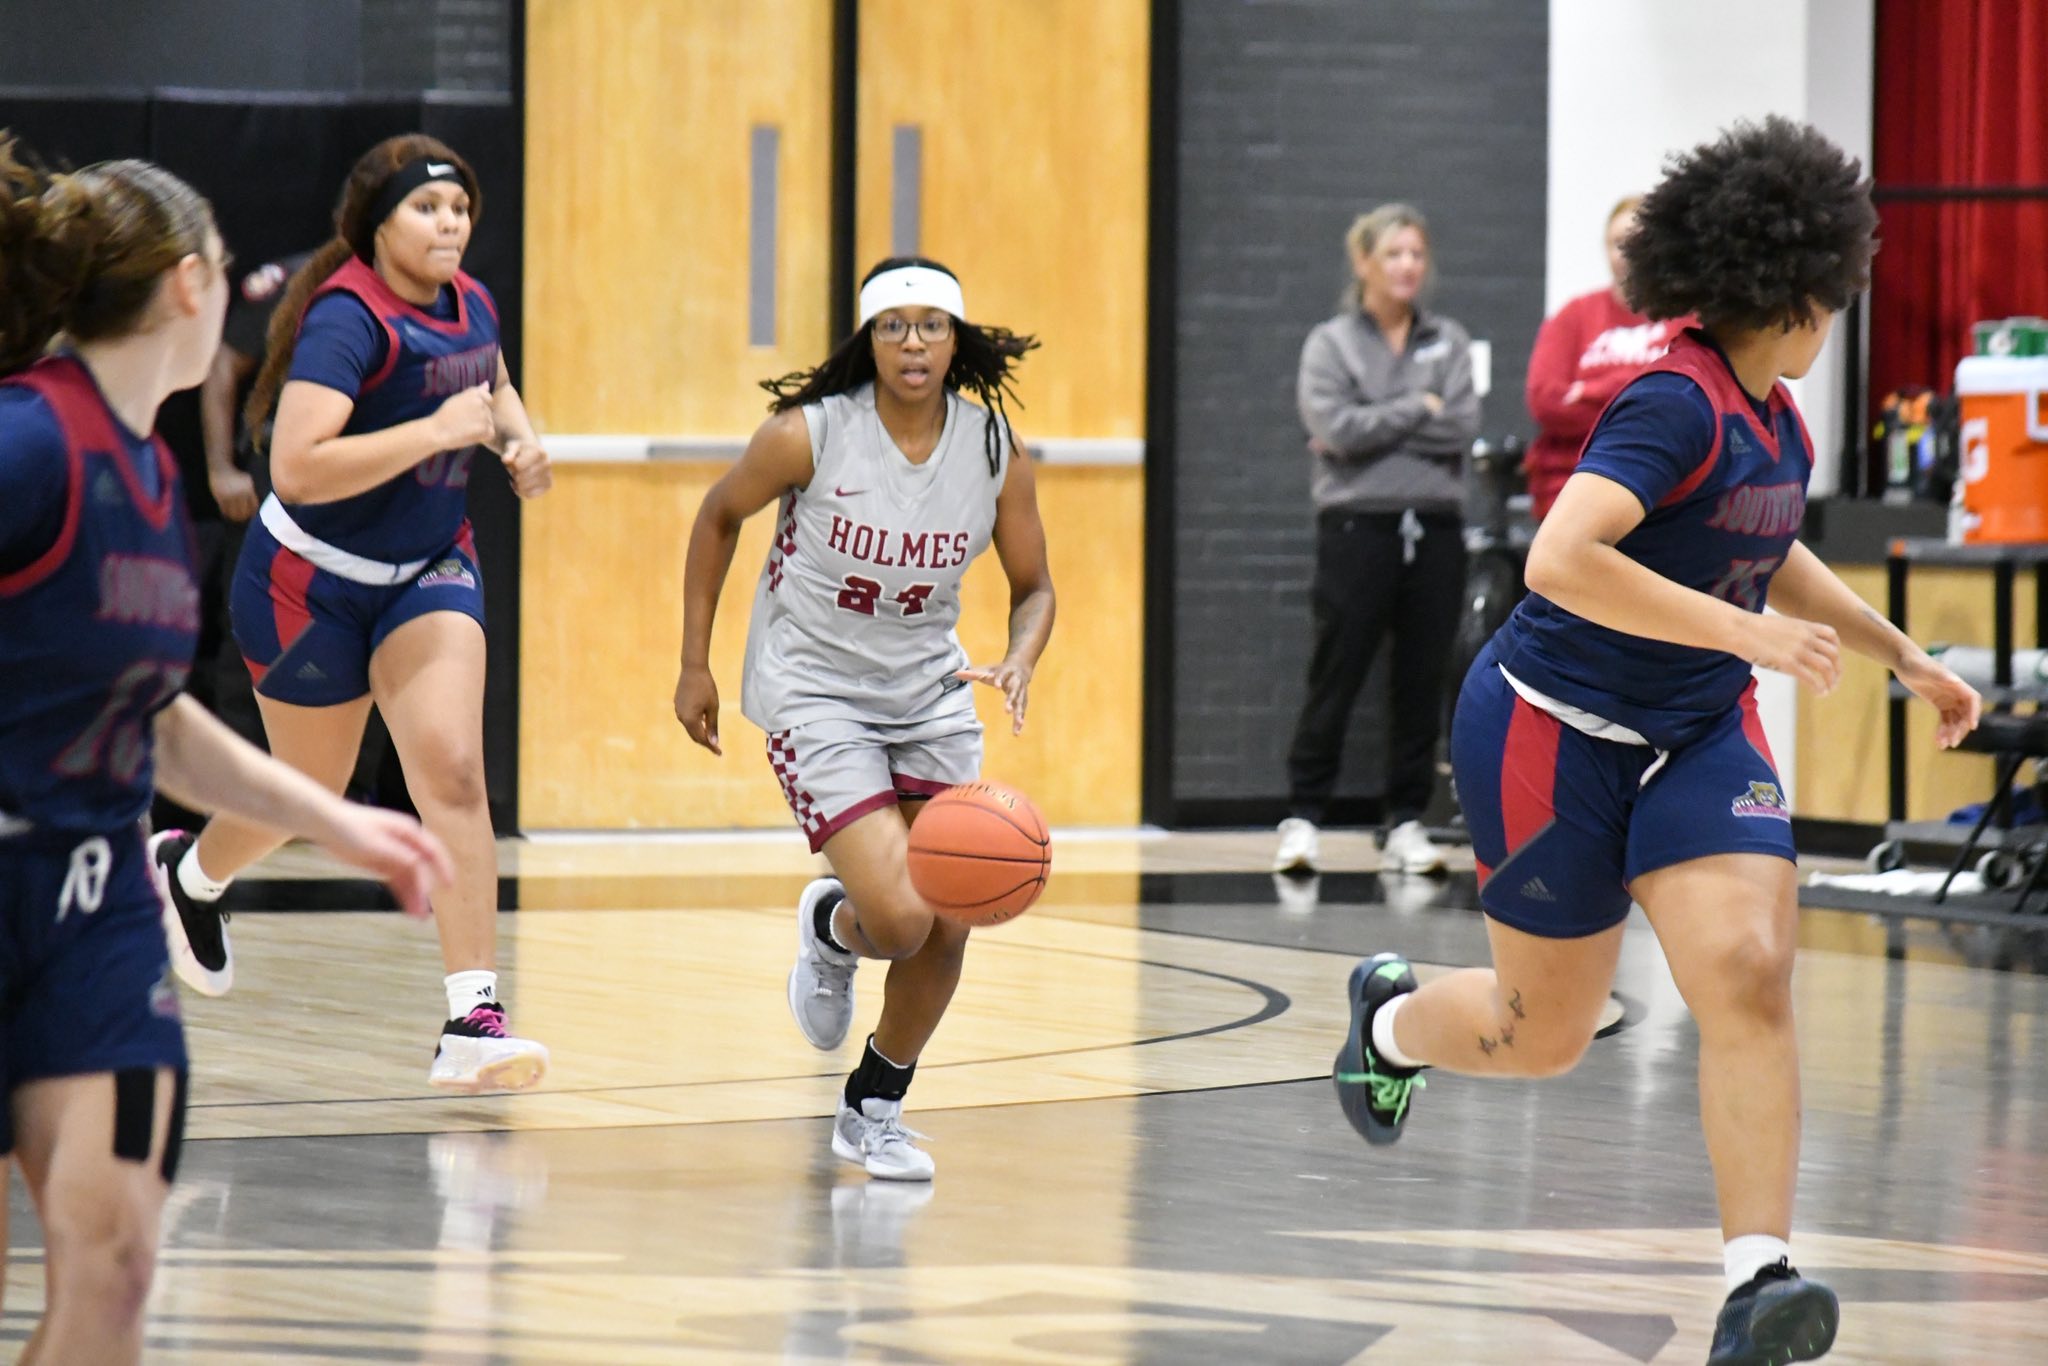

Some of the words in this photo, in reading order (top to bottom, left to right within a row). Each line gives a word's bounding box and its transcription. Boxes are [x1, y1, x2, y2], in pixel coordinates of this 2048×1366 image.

[1959, 417, 1989, 482] G
[827, 514, 970, 569] HOLMES
[835, 573, 938, 617] 24
